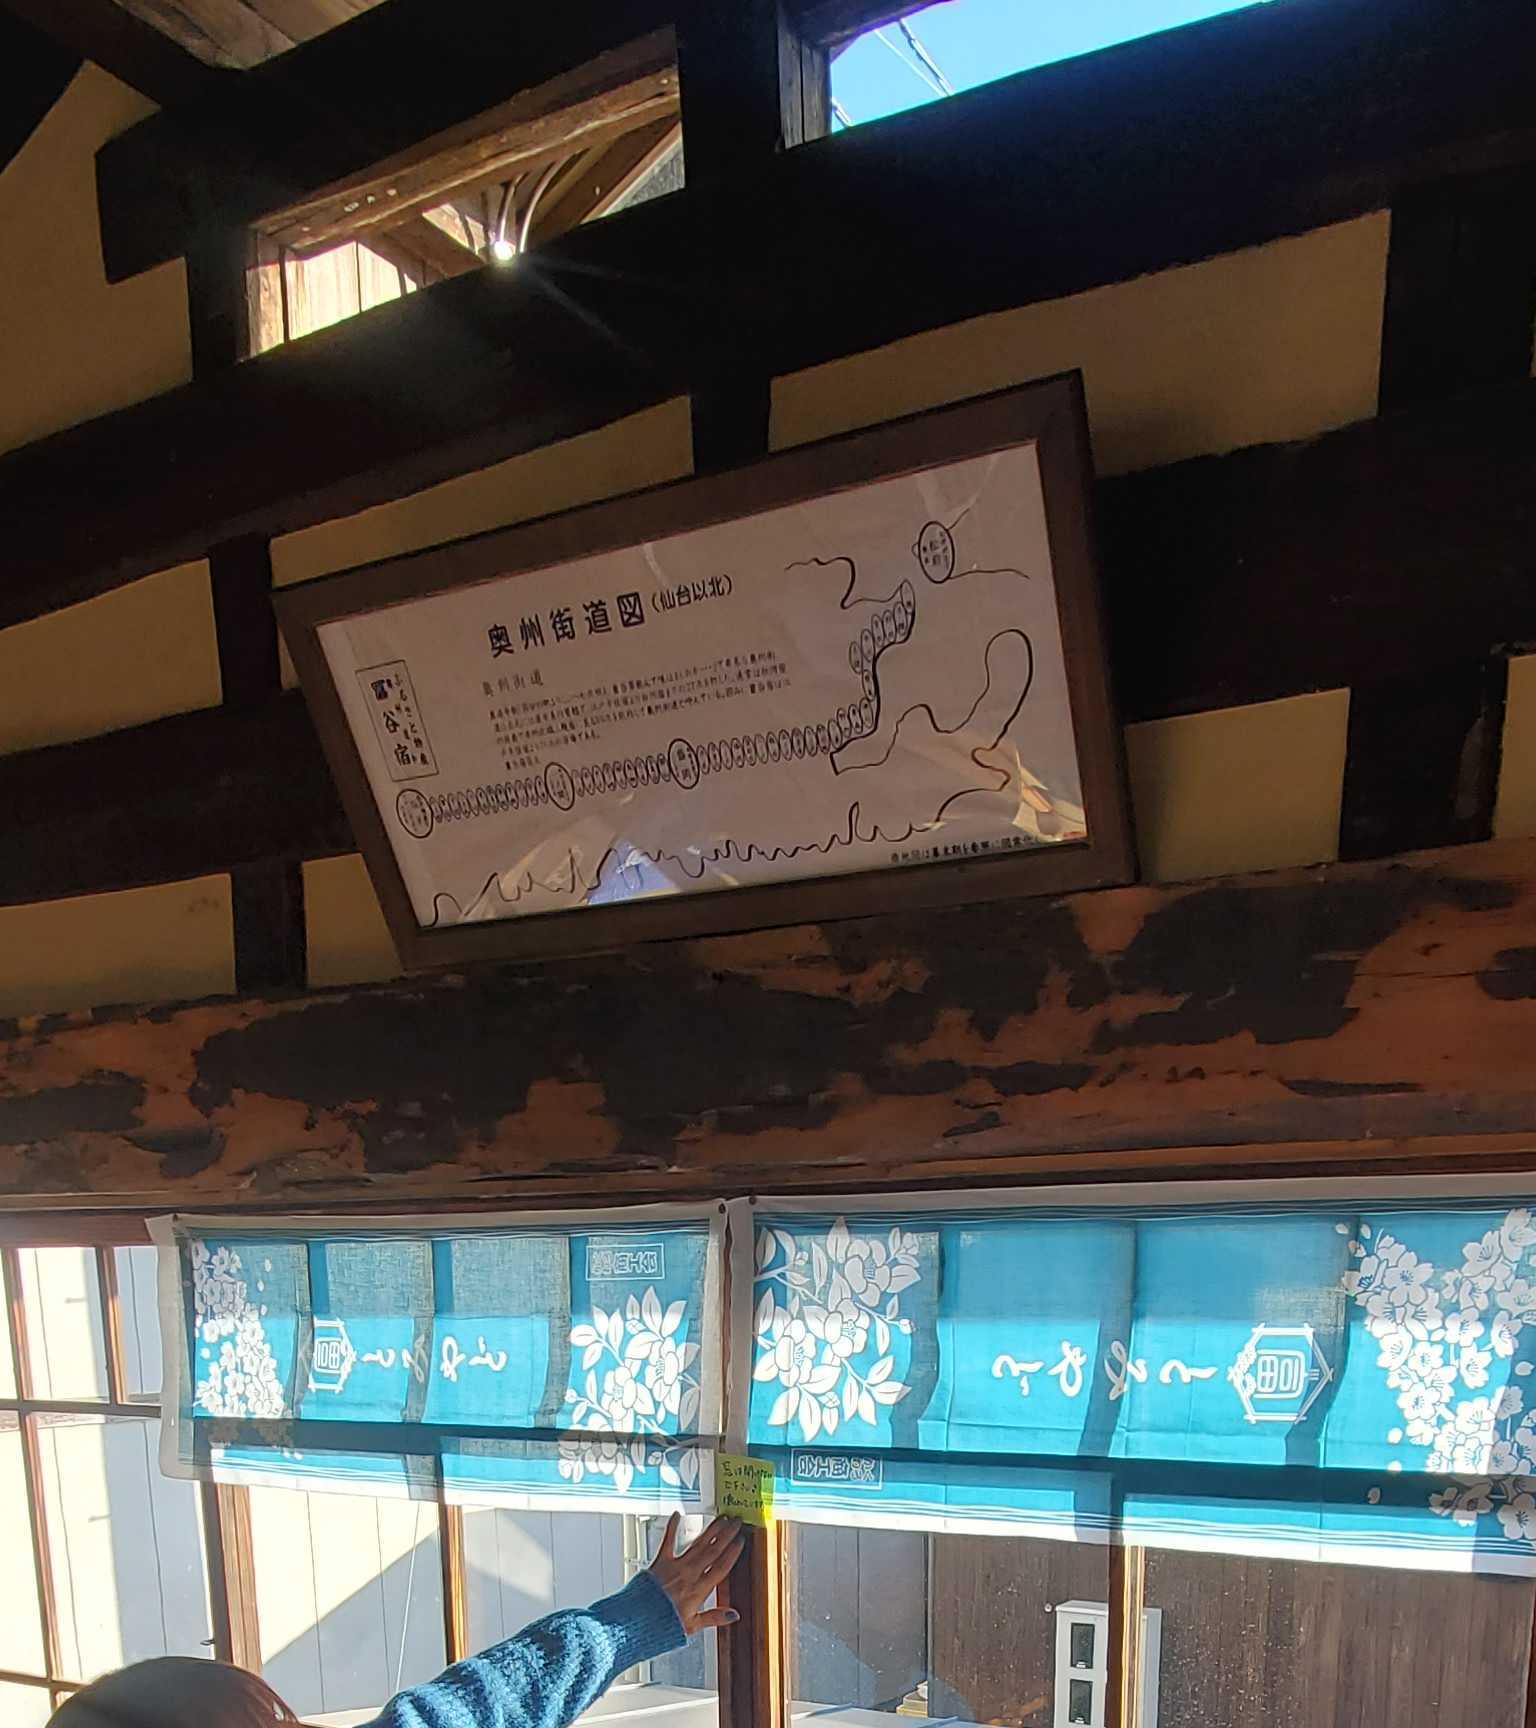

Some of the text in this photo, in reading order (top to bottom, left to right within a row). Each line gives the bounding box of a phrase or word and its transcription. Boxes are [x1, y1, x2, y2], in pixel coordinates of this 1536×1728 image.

[487, 591, 645, 658] 奥州街道図
[360, 1333, 509, 1383] とみやど
[990, 1339, 1219, 1401] とみやど
